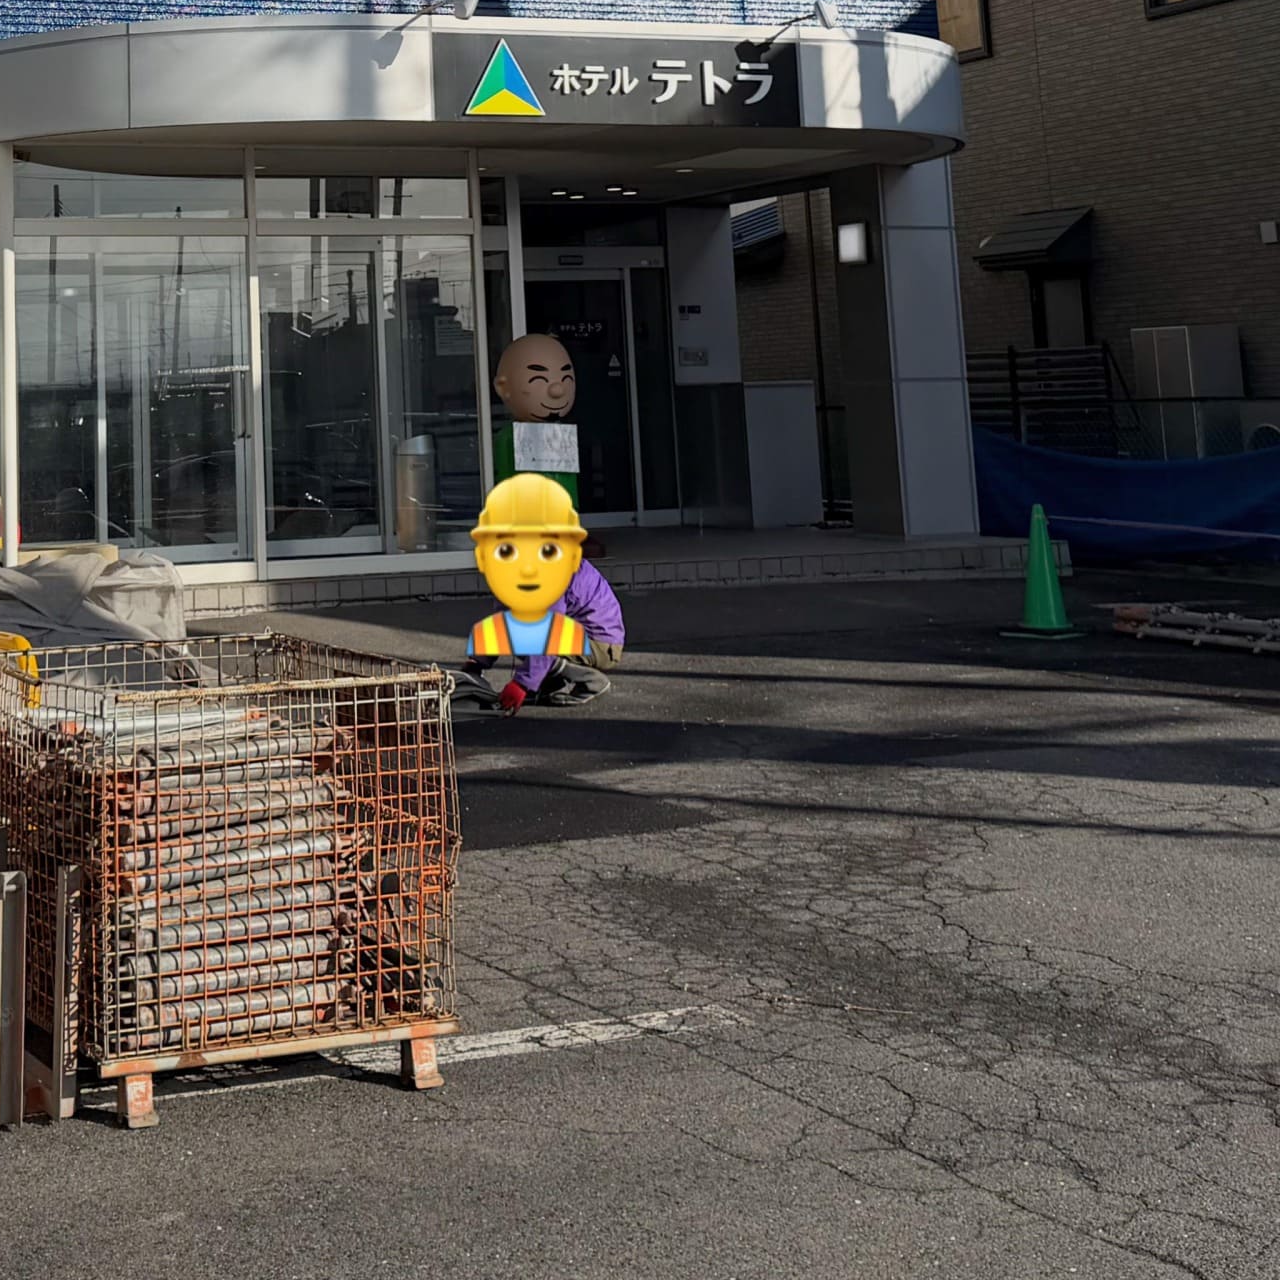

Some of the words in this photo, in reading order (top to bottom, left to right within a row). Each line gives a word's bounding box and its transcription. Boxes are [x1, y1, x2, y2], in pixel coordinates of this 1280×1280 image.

[552, 63, 639, 96] ホテル
[650, 60, 773, 105] テトラ
